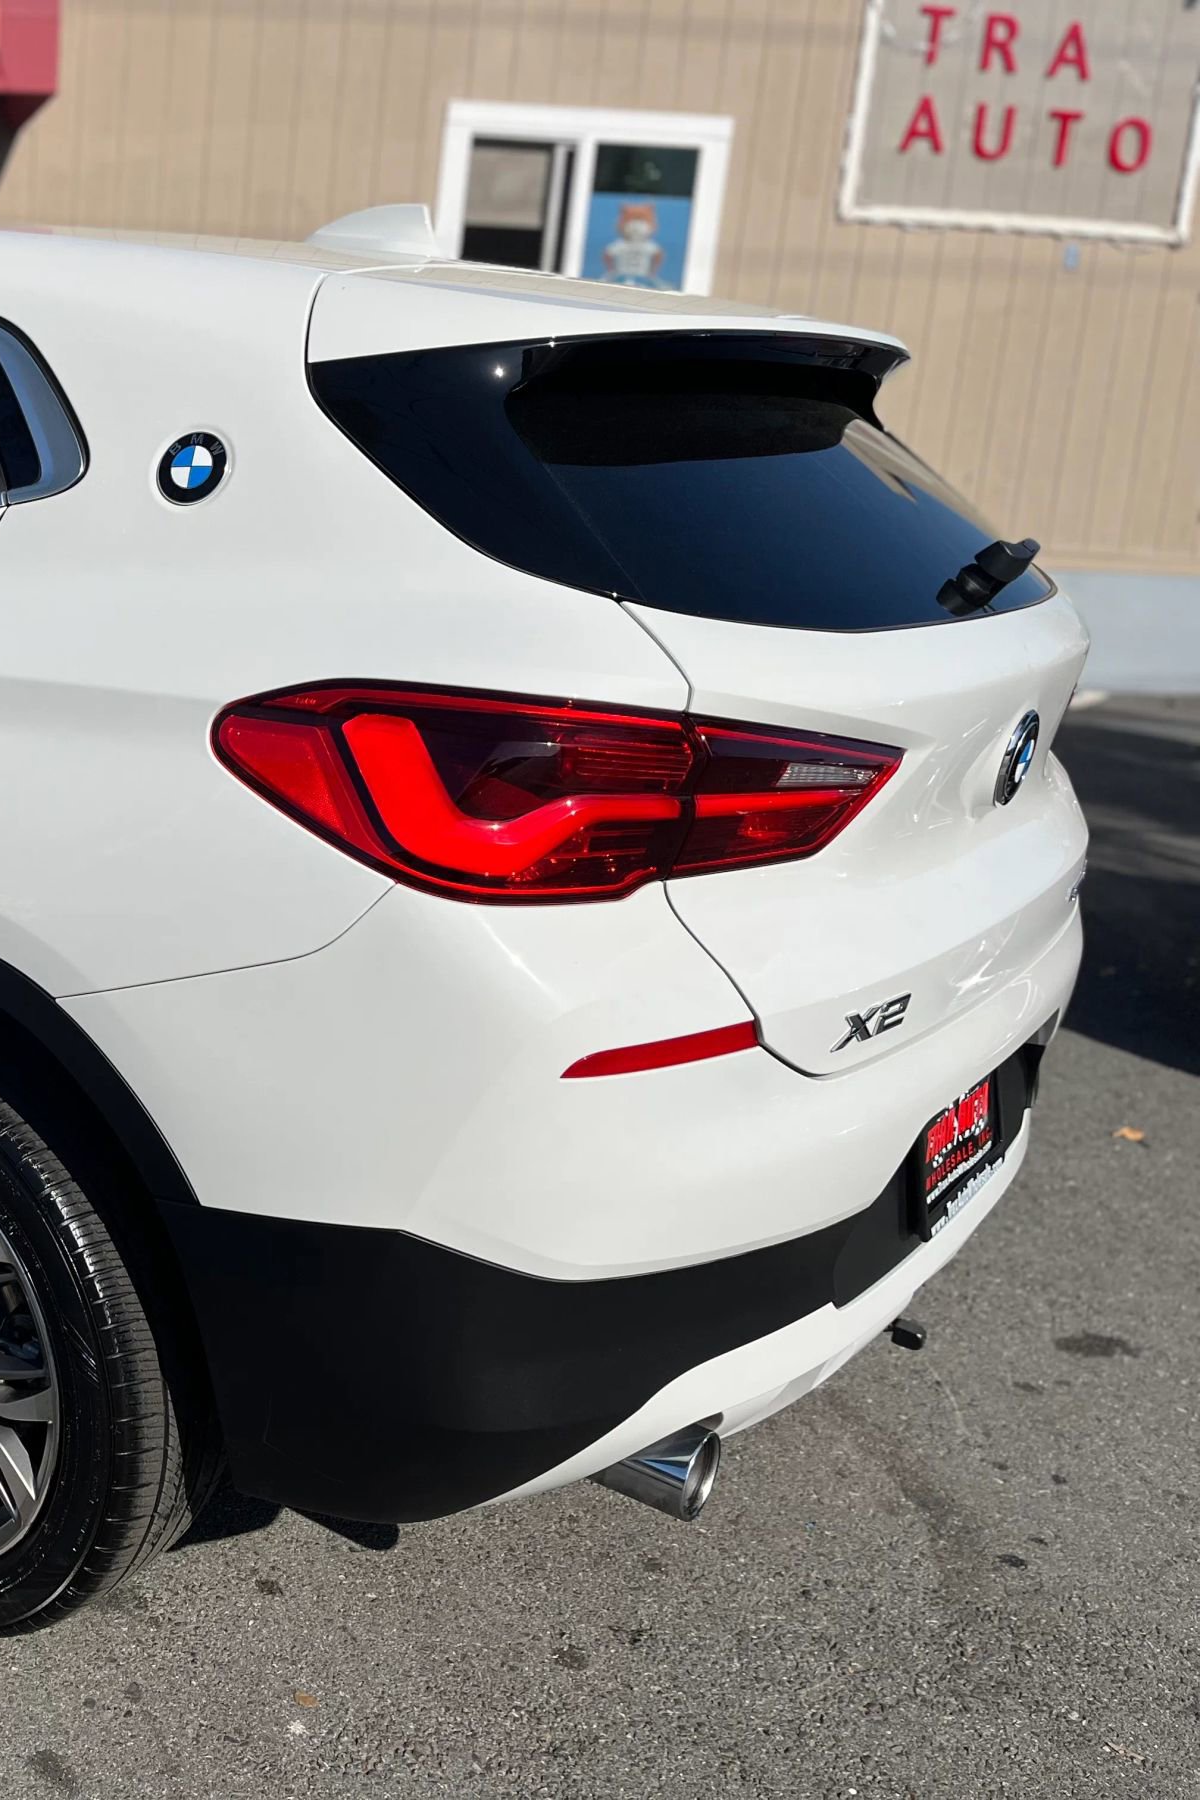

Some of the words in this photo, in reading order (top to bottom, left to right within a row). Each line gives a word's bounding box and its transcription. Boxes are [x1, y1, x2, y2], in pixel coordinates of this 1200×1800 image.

[920, 5, 1091, 82] TRA
[898, 93, 1153, 174] AUTO
[168, 433, 225, 456] BMW
[830, 992, 912, 1053] X2
